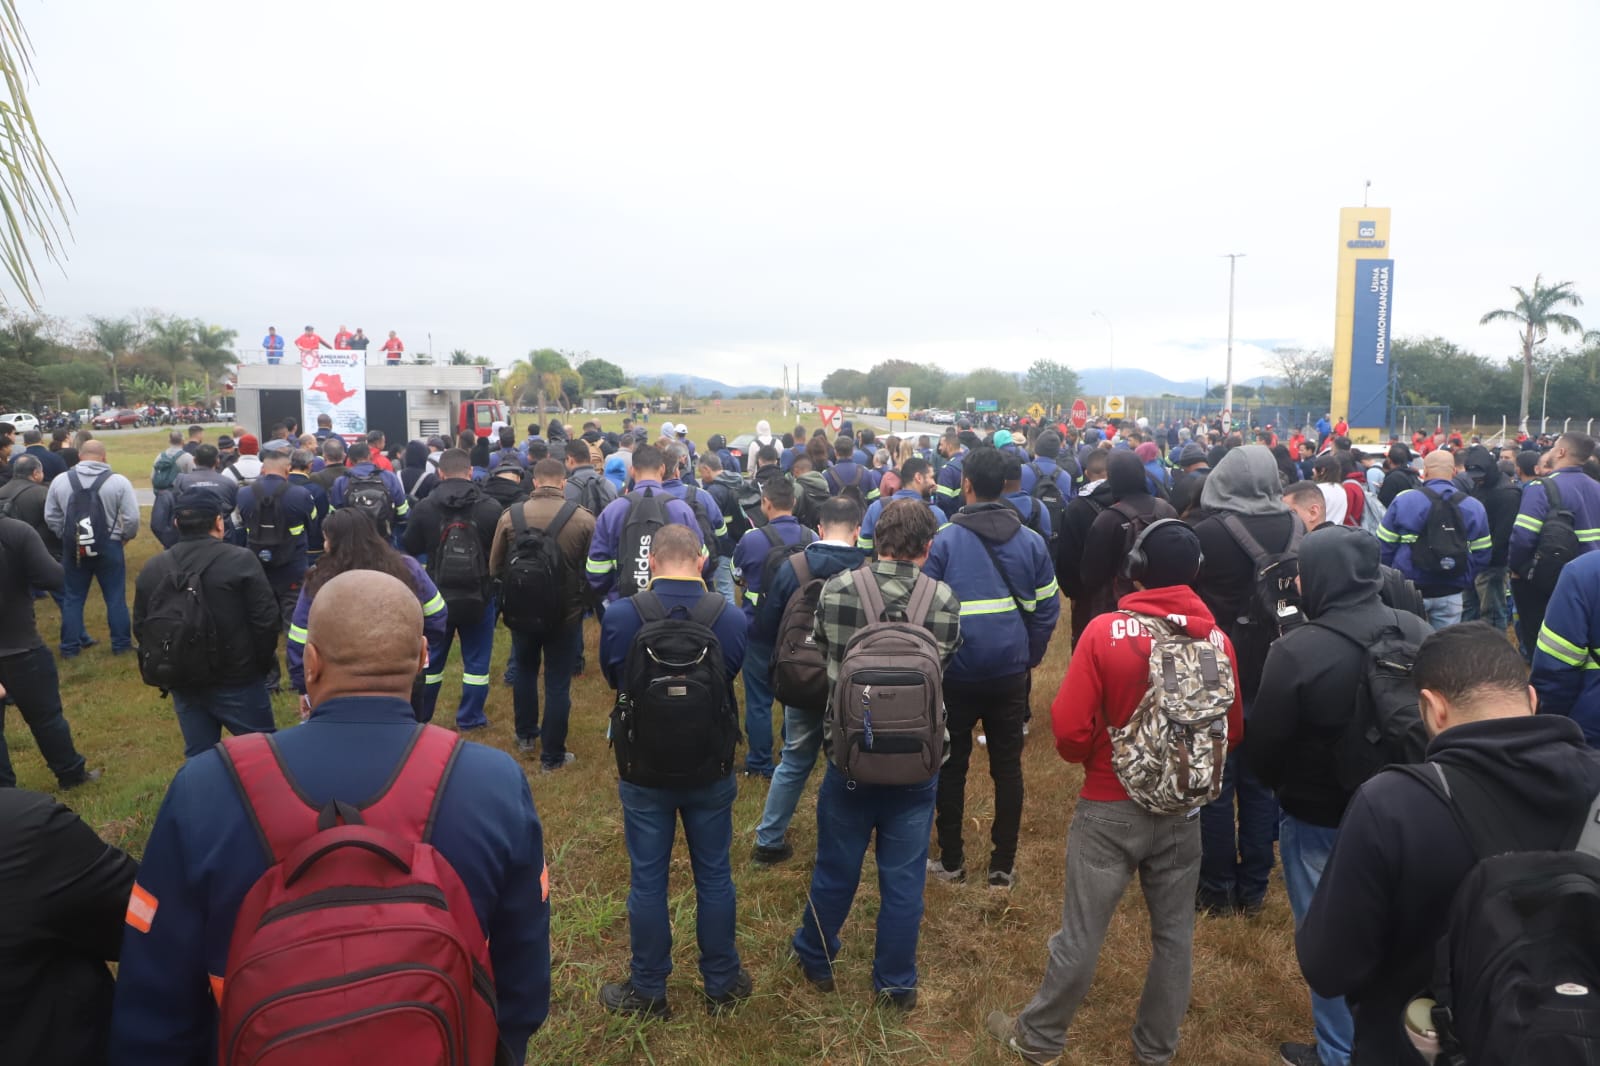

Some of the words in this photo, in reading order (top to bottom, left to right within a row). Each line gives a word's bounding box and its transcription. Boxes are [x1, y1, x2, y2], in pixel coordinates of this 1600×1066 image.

[1370, 267, 1380, 292] USINA
[1376, 266, 1389, 364] PINDAMONHANGABA
[1072, 409, 1086, 420] PARE
[633, 534, 652, 592] didas
